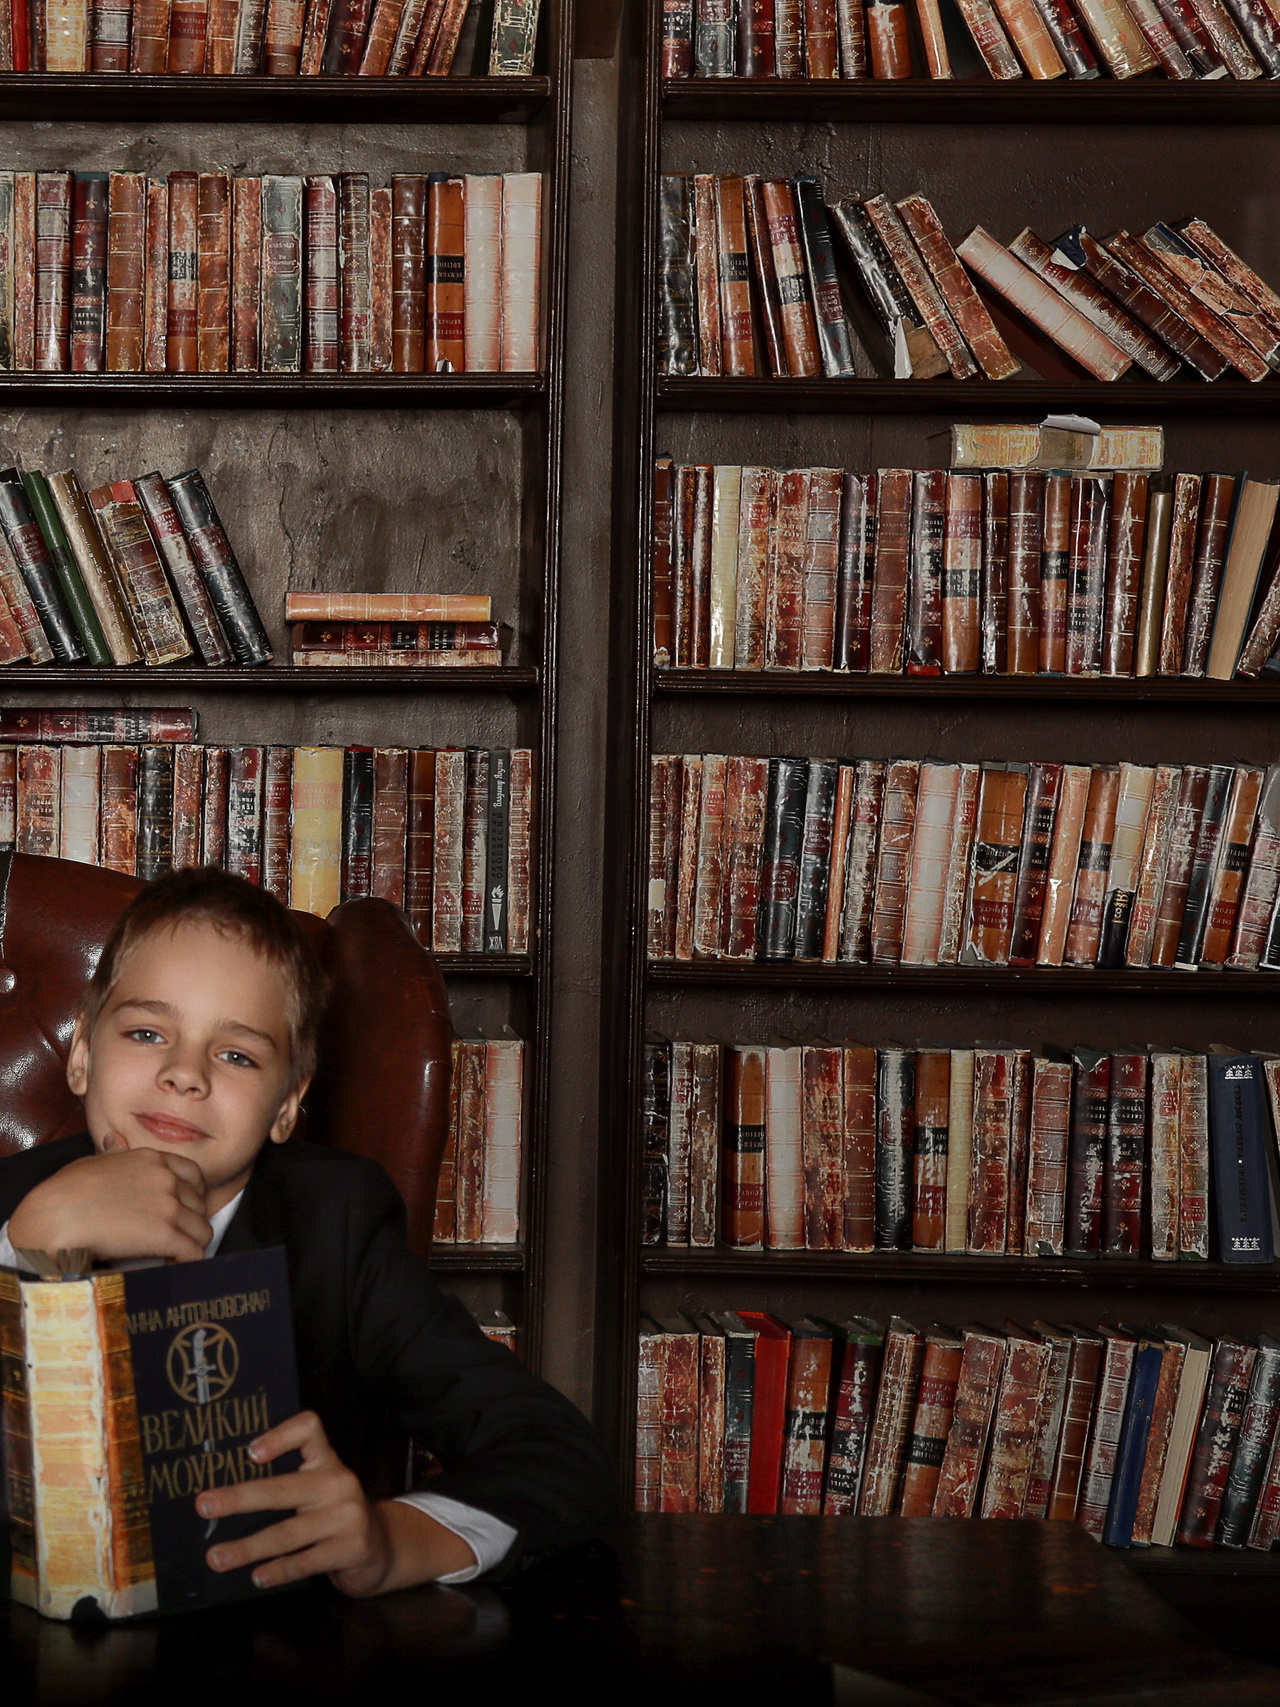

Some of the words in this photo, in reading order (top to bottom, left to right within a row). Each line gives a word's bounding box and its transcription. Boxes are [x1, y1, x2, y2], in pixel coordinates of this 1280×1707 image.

[496, 811, 505, 879] ОДОЕВСКИЙ
[166, 1290, 271, 1327] АНТОНОВСКАЯ
[142, 1386, 269, 1454] ВЕЛИКИЙ
